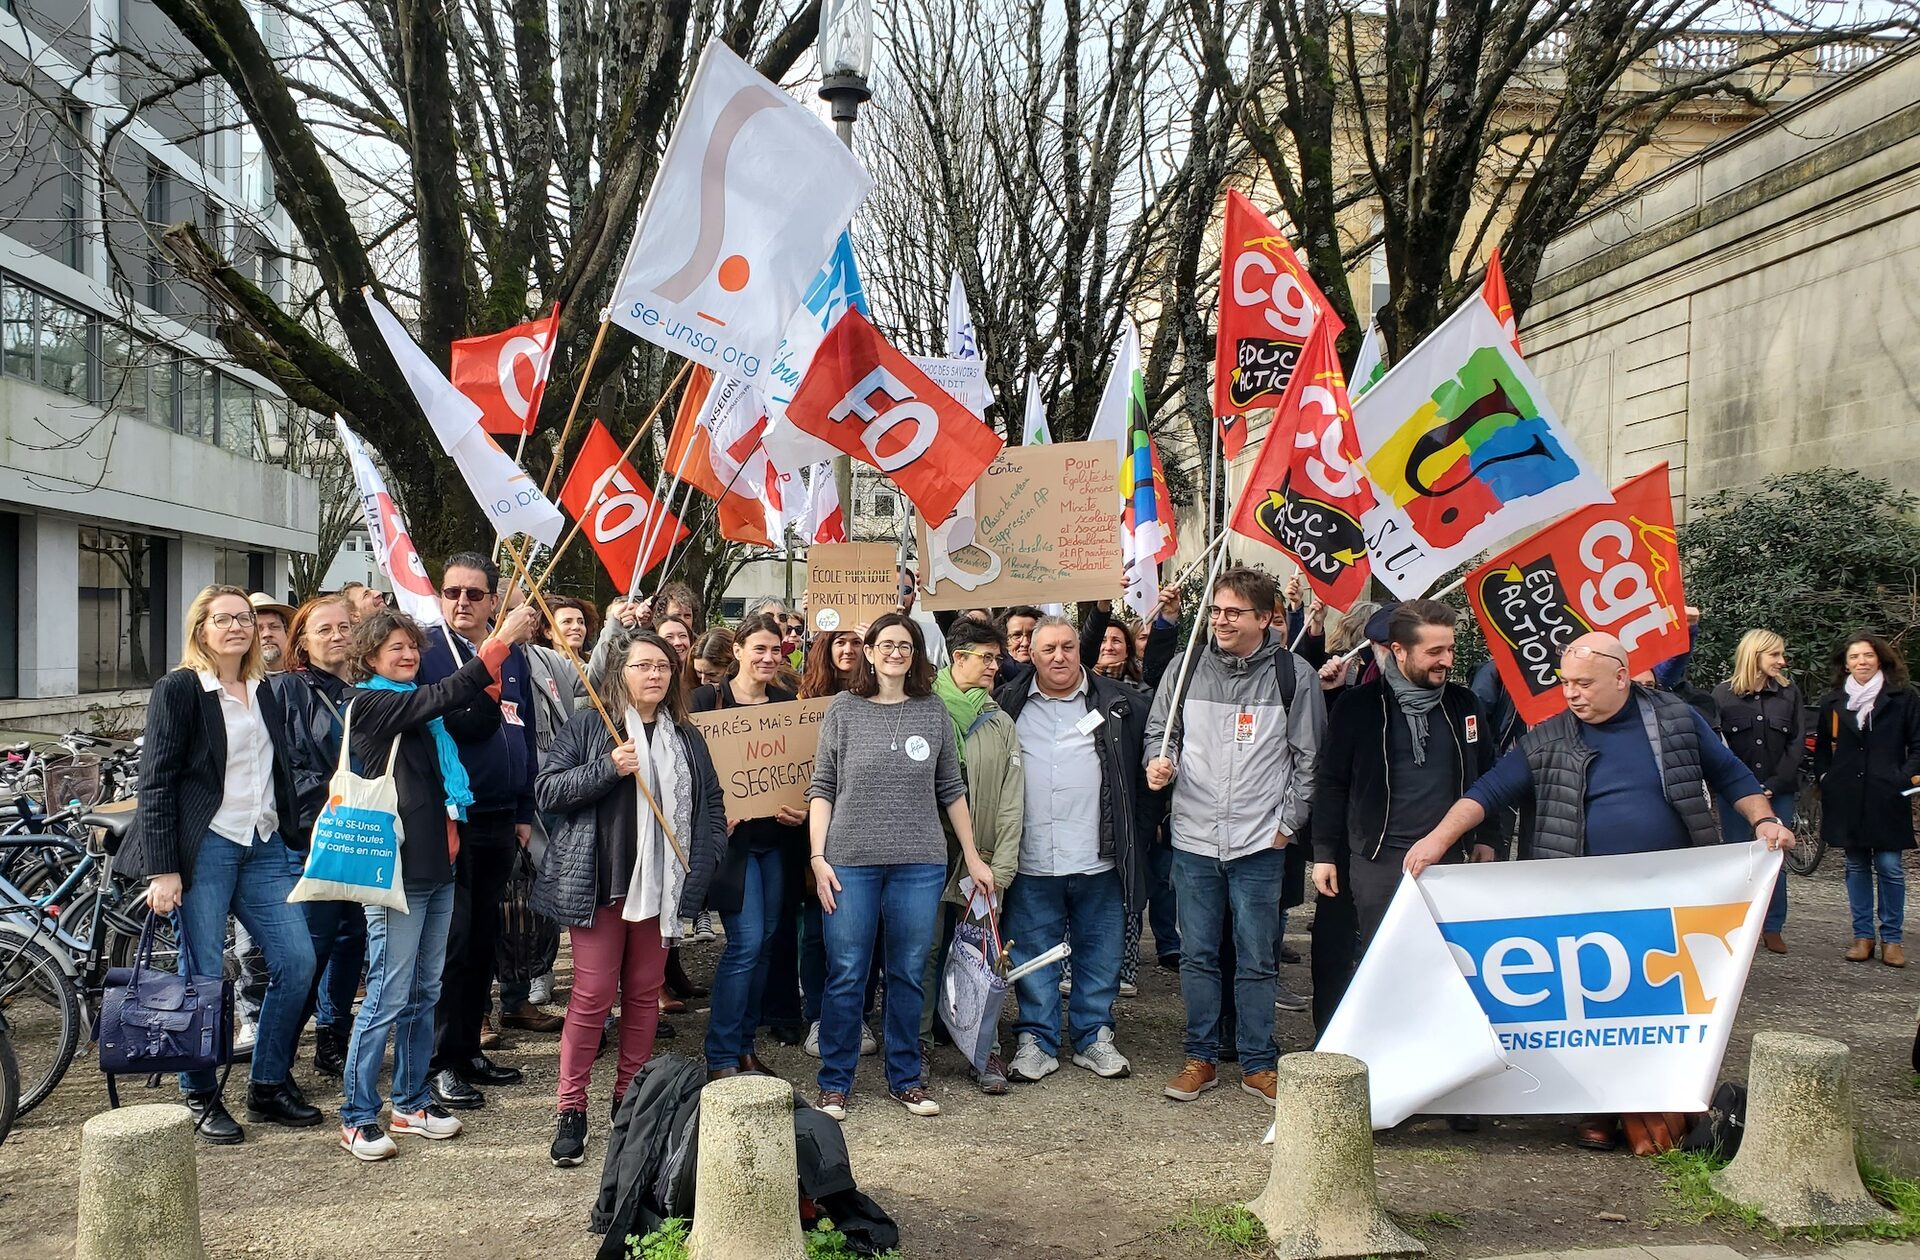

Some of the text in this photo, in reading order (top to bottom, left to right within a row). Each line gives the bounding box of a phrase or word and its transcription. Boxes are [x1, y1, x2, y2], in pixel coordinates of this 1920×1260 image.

[1233, 251, 1320, 338] cg
[630, 301, 762, 377] se-unsa.org
[947, 380, 965, 389] DIT
[827, 365, 939, 472] FO
[987, 462, 1024, 476] Contre
[1065, 457, 1099, 471] Pour
[1033, 487, 1049, 508] AP
[1075, 509, 1117, 524] scolaire
[1074, 521, 1117, 534] sociale
[999, 542, 1014, 554] Tri
[812, 565, 843, 583] ÉCOLE
[1579, 519, 1678, 653] cgt
[812, 590, 897, 606] PRIVÉE DE MOYENS
[746, 734, 787, 761] NON
[335, 817, 345, 827] le
[334, 831, 355, 842] avez
[356, 833, 385, 844] toutes
[327, 843, 355, 854] cartes
[356, 846, 368, 856] en
[370, 848, 393, 858] main
[1498, 1025, 1690, 1051] ENSEIGNEMENT
